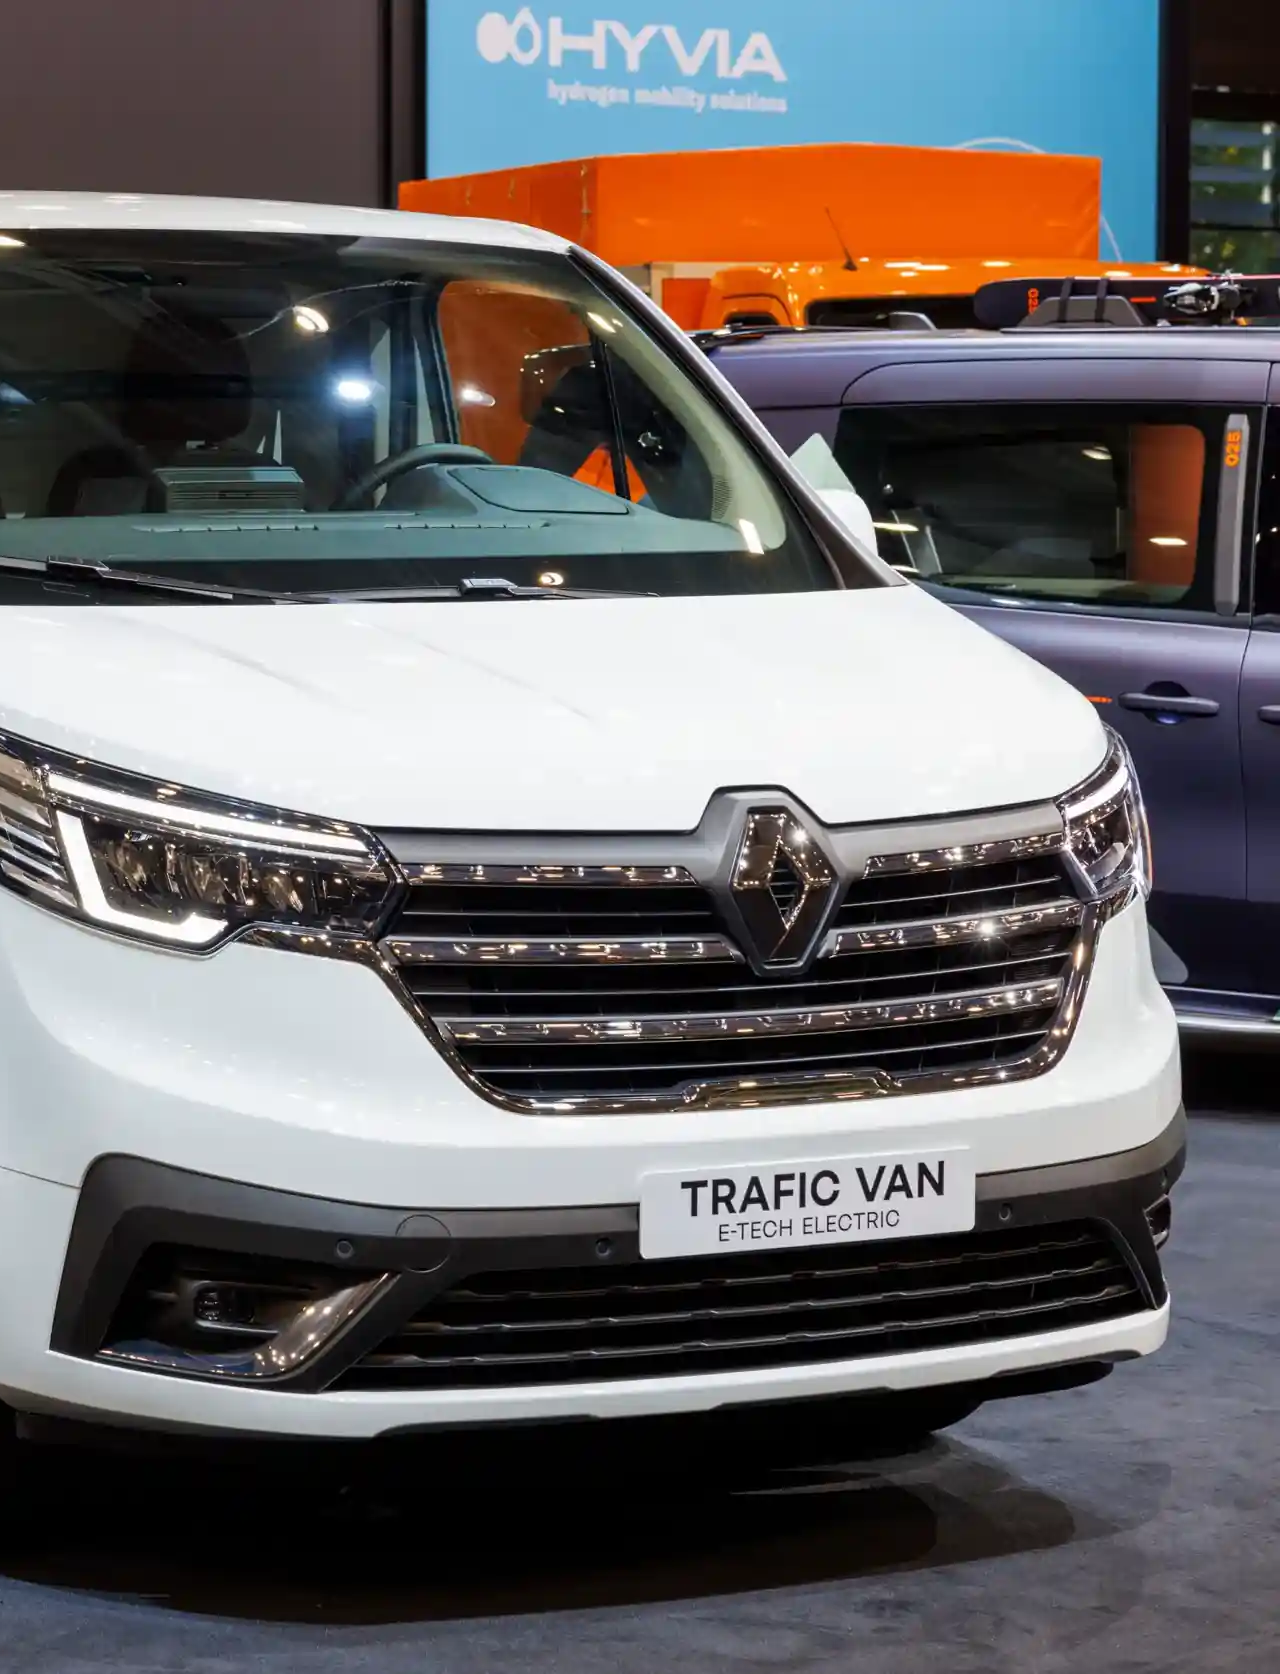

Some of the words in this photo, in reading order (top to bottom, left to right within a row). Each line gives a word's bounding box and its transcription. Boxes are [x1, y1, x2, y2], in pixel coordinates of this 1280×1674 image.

[548, 16, 787, 82] HYVIA
[547, 78, 630, 108] hydrogen
[634, 86, 706, 113] mobility
[710, 89, 787, 113] solutions
[681, 1169, 840, 1217] TRAFIC
[856, 1161, 944, 1201] VAN
[718, 1219, 793, 1242] E-TECH
[803, 1209, 901, 1235] ELECTRIC
